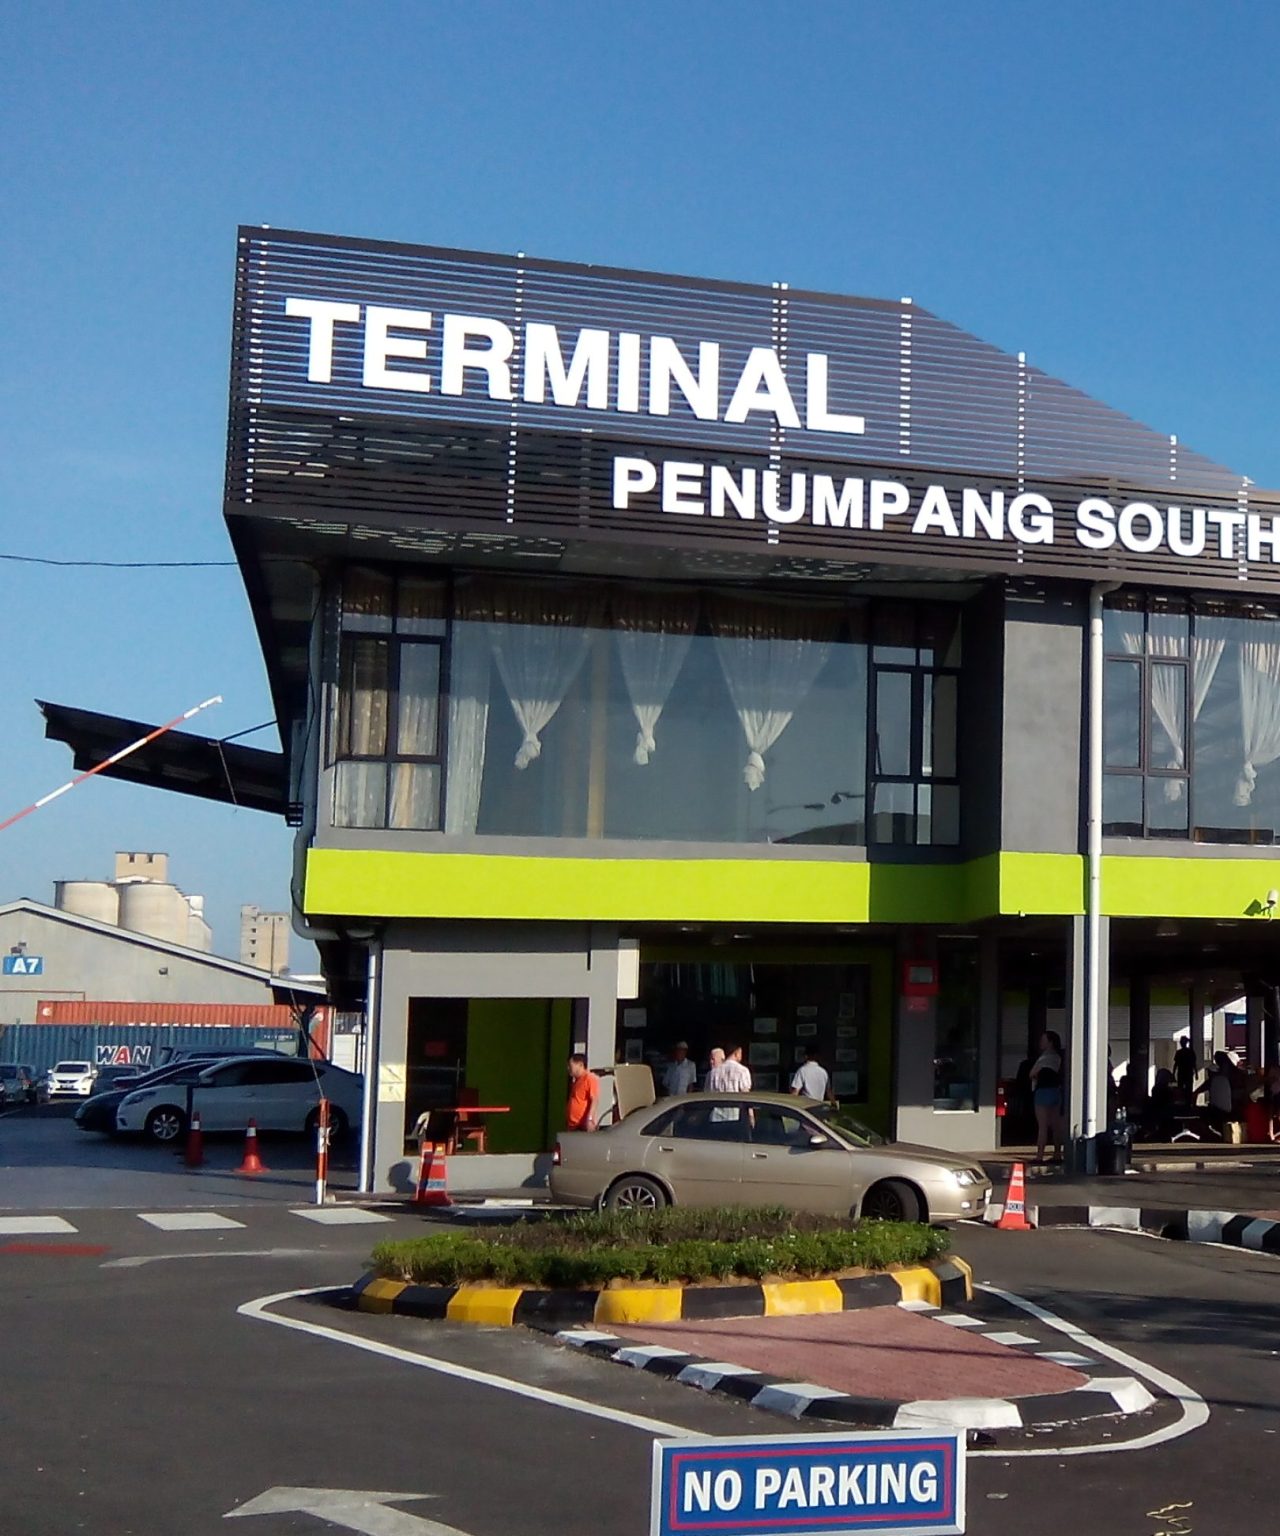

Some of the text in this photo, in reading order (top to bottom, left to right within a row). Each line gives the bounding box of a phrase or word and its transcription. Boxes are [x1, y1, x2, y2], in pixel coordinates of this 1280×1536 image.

[285, 297, 866, 434] TERMINAL
[613, 456, 1054, 545] PENUMPANG
[12, 957, 39, 973] A7
[95, 1045, 151, 1065] WAN
[683, 1462, 937, 1512] NO PARKING
